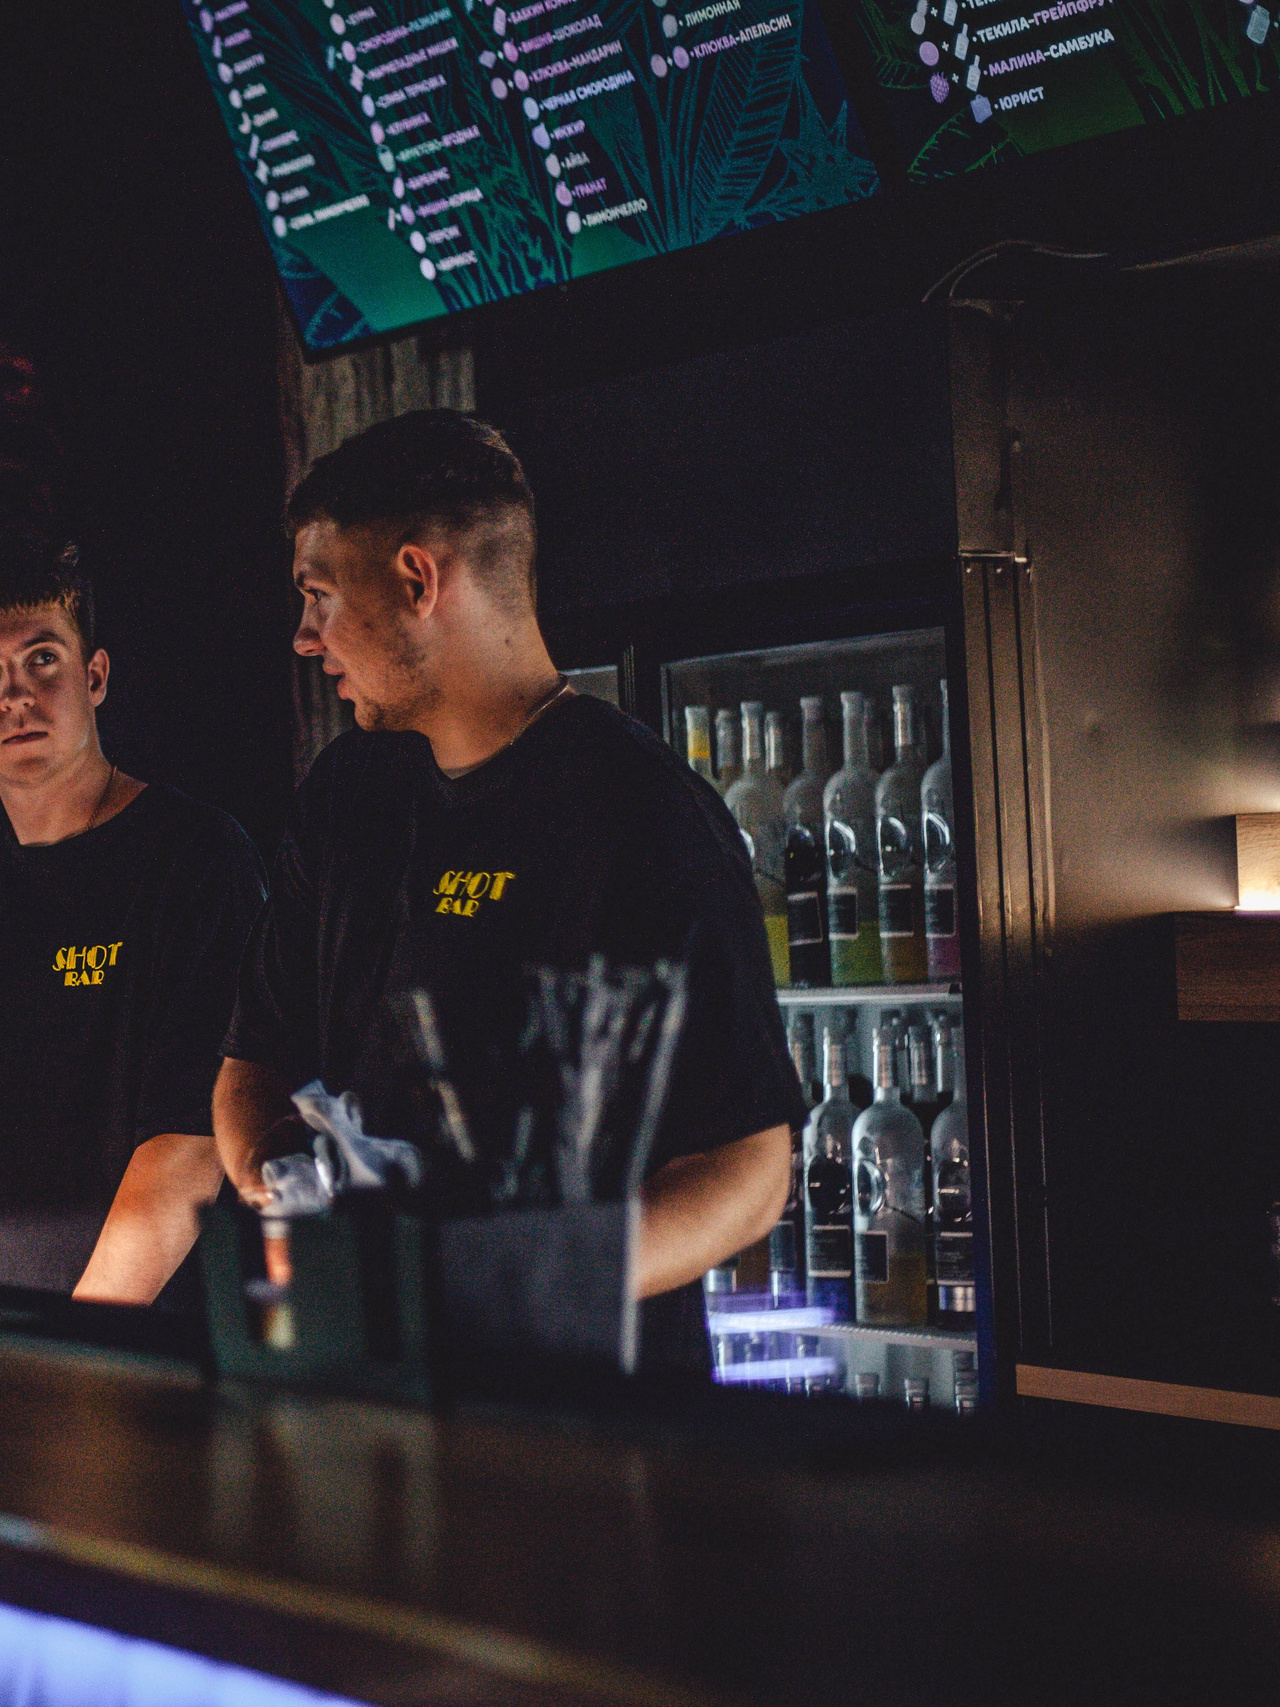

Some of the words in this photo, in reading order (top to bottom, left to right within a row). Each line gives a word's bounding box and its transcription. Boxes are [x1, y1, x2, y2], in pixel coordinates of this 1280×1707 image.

[685, 0, 741, 27] ЛИМОННАЯ
[693, 14, 792, 59] КЛЮКВА-АПЕЛЬСИН
[988, 28, 1115, 77] МАЛИНА-САМБУКА
[998, 86, 1045, 111] ЮРИСТ
[574, 177, 608, 199] ГРАНАТ
[586, 197, 649, 228] ЛИМОНЧЕЛЛО
[433, 870, 516, 901] SHOT
[435, 897, 480, 917] BAR
[52, 942, 123, 971] SHOT
[64, 970, 105, 987] BAR
